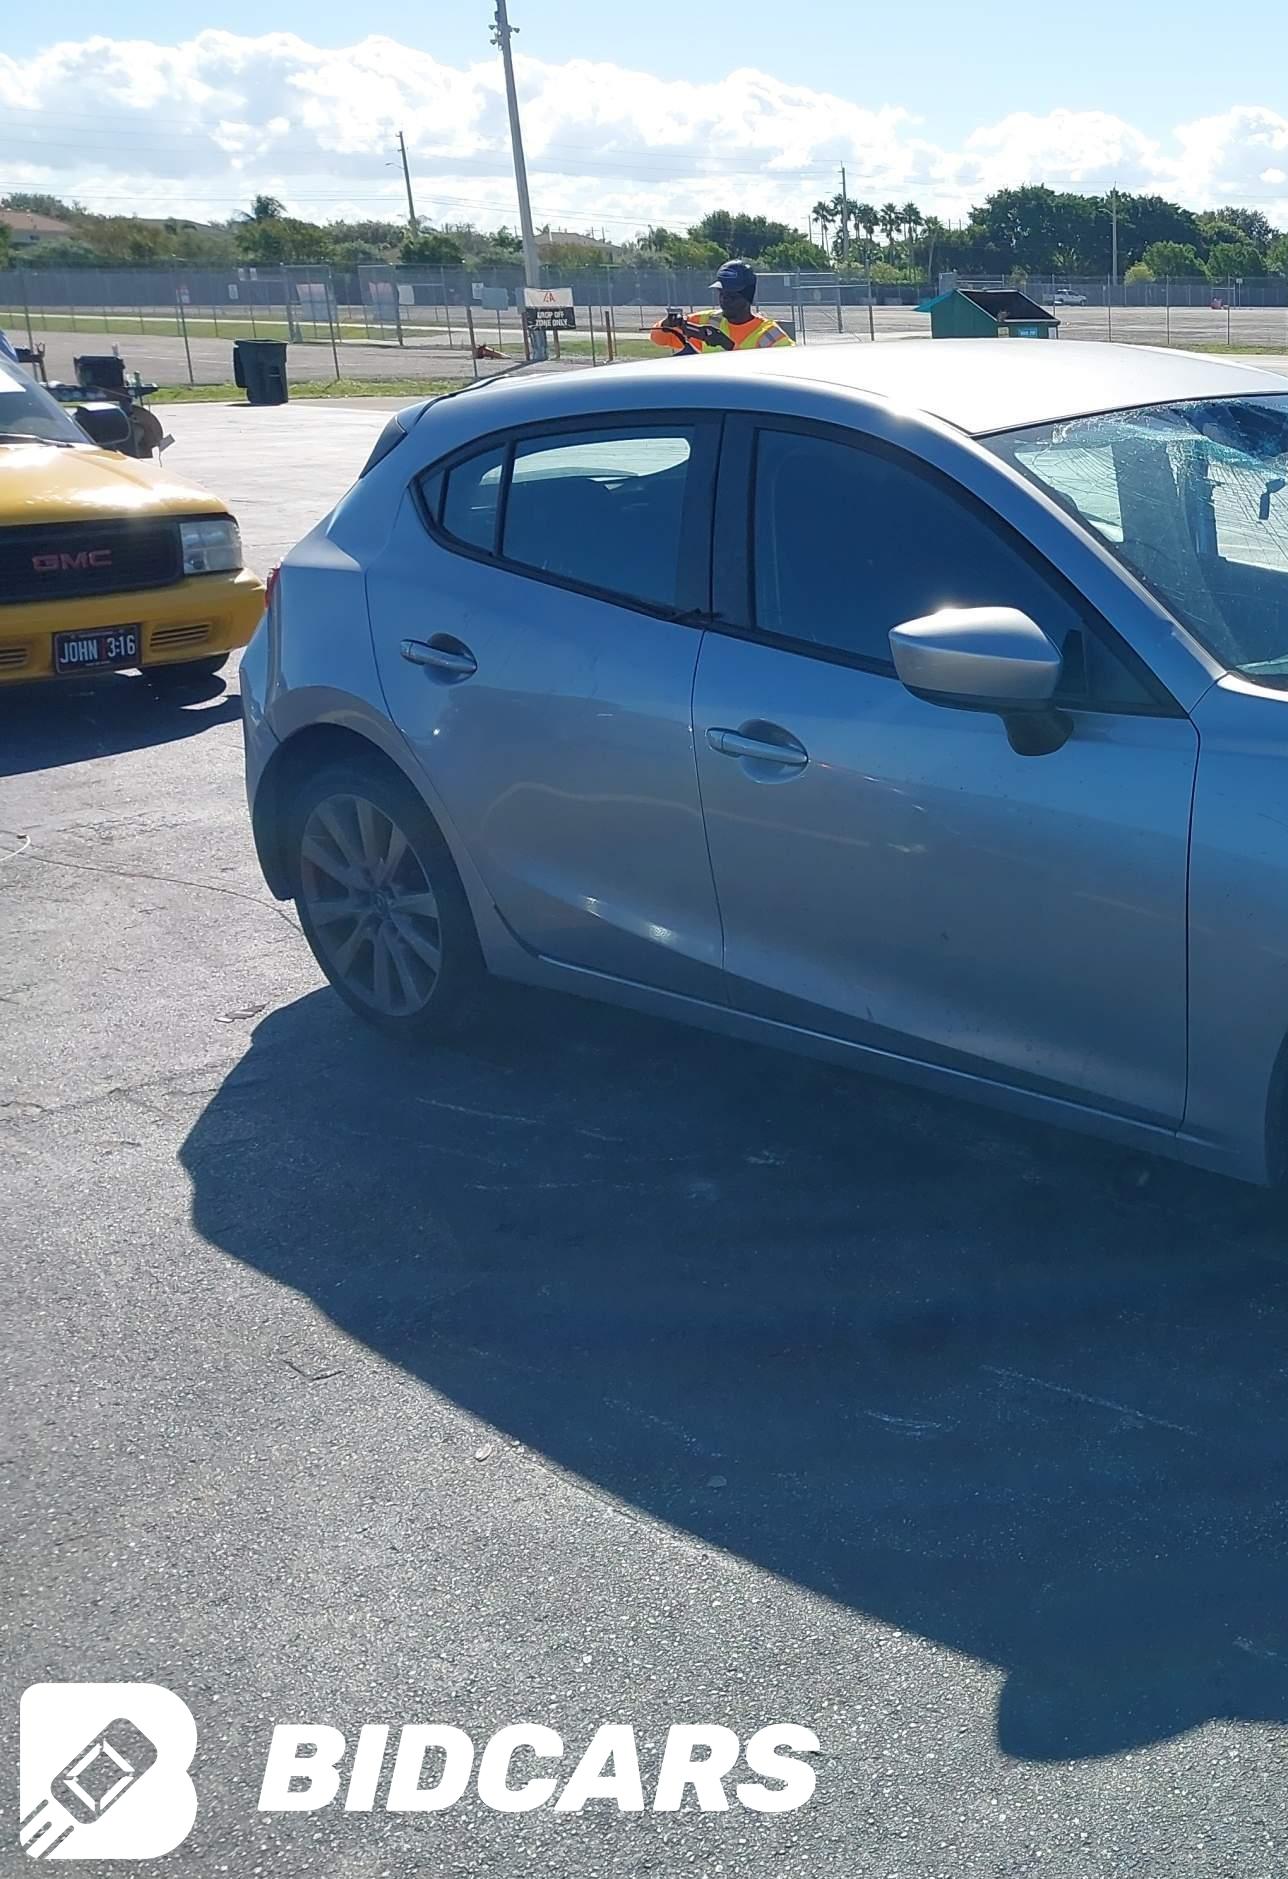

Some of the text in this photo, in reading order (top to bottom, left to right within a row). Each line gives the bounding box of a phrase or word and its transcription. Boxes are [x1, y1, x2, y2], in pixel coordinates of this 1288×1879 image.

[32, 549, 112, 571] GMC
[60, 635, 136, 663] JOHN 3:16
